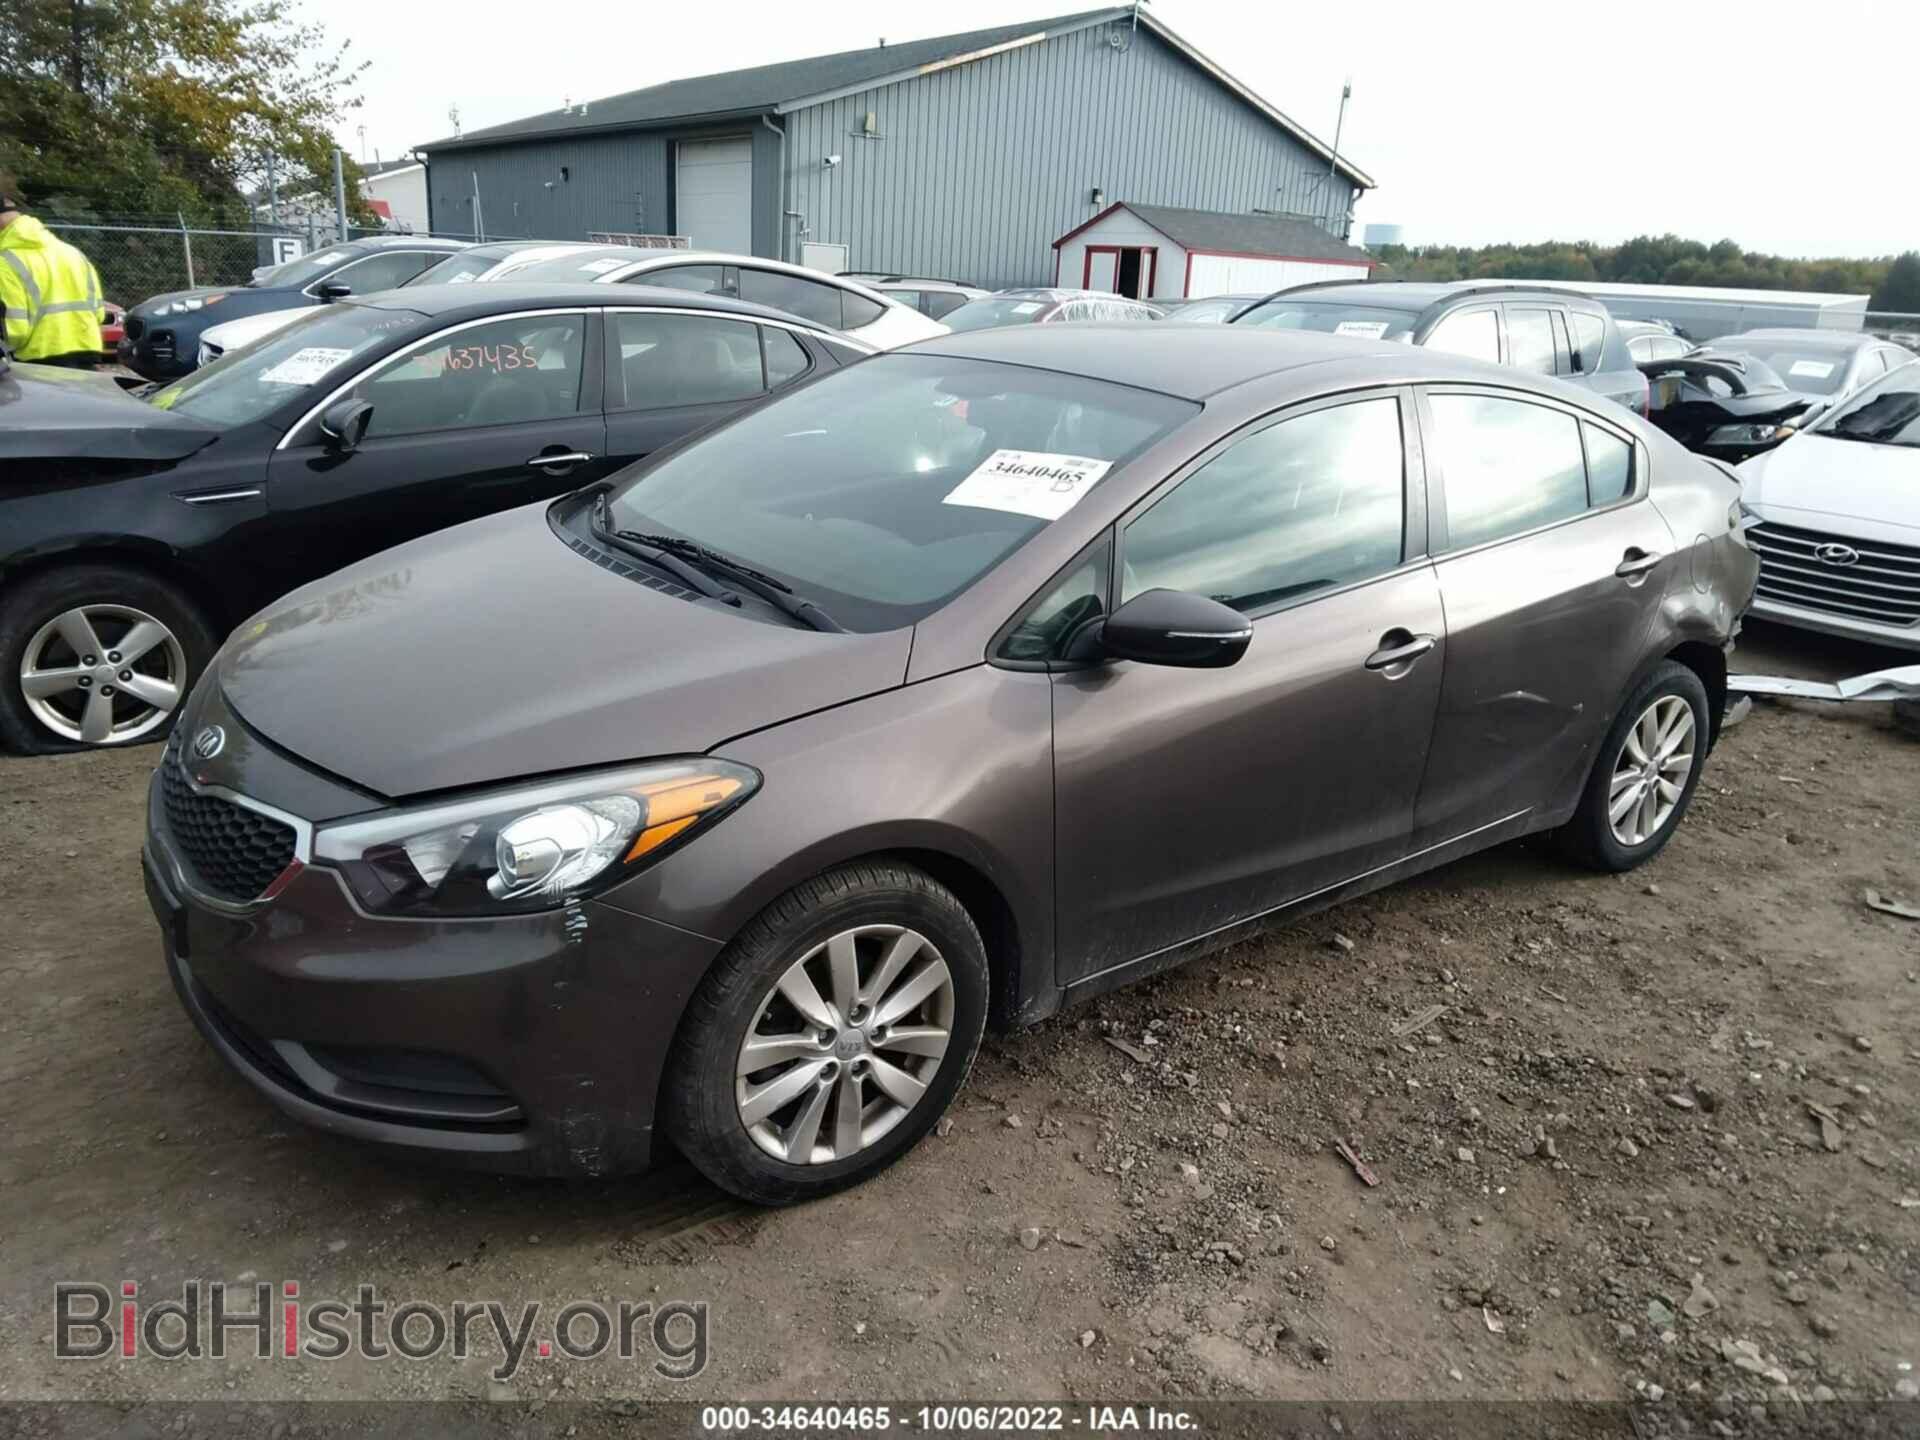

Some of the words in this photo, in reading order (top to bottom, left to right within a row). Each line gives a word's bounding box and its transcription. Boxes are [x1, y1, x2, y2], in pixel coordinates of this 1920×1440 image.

[279, 241, 295, 263] F
[412, 344, 537, 372] 637435
[988, 461, 1086, 483] 34640465
